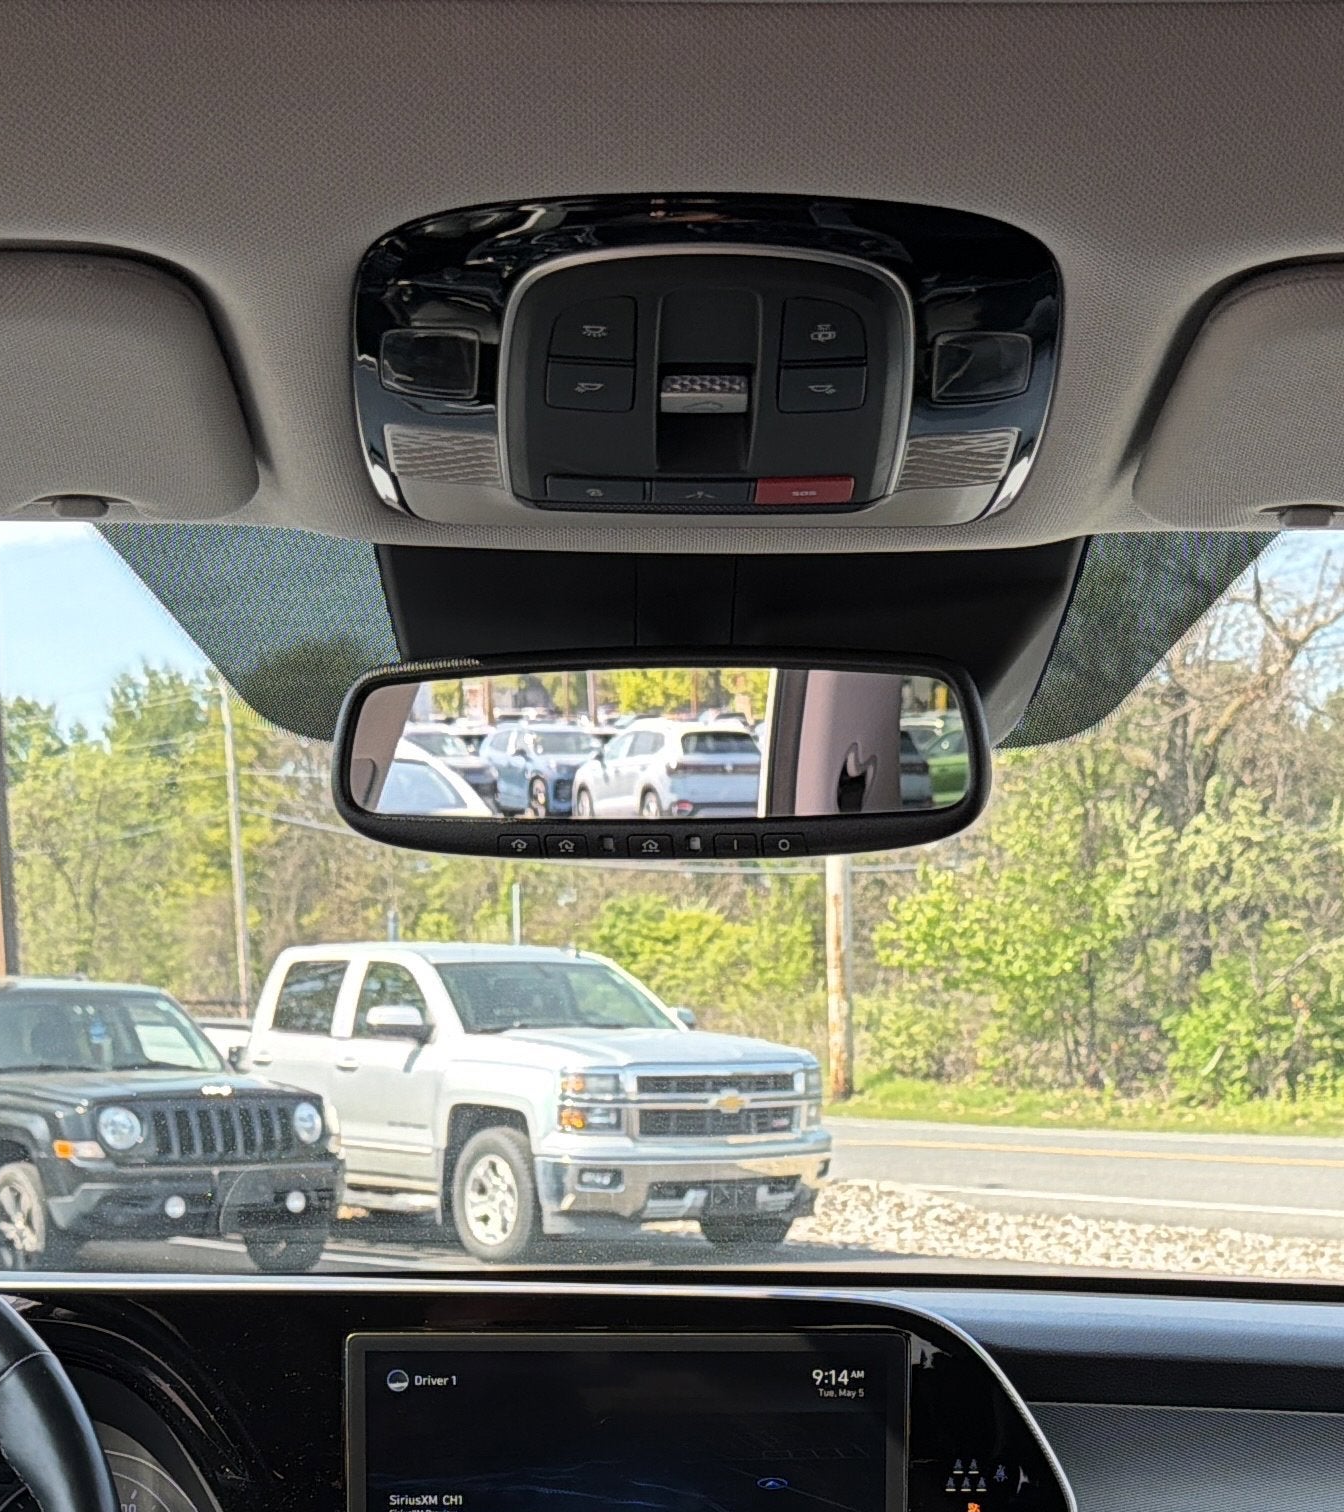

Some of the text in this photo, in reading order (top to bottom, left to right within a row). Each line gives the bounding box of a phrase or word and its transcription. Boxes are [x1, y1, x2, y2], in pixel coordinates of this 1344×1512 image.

[414, 1375, 457, 1386] Driver 1
[812, 1369, 865, 1386] 9:14 AM
[818, 1388, 837, 1398] Tue,
[838, 1388, 857, 1399] May
[389, 1494, 463, 1506] SiriusXM CH1
